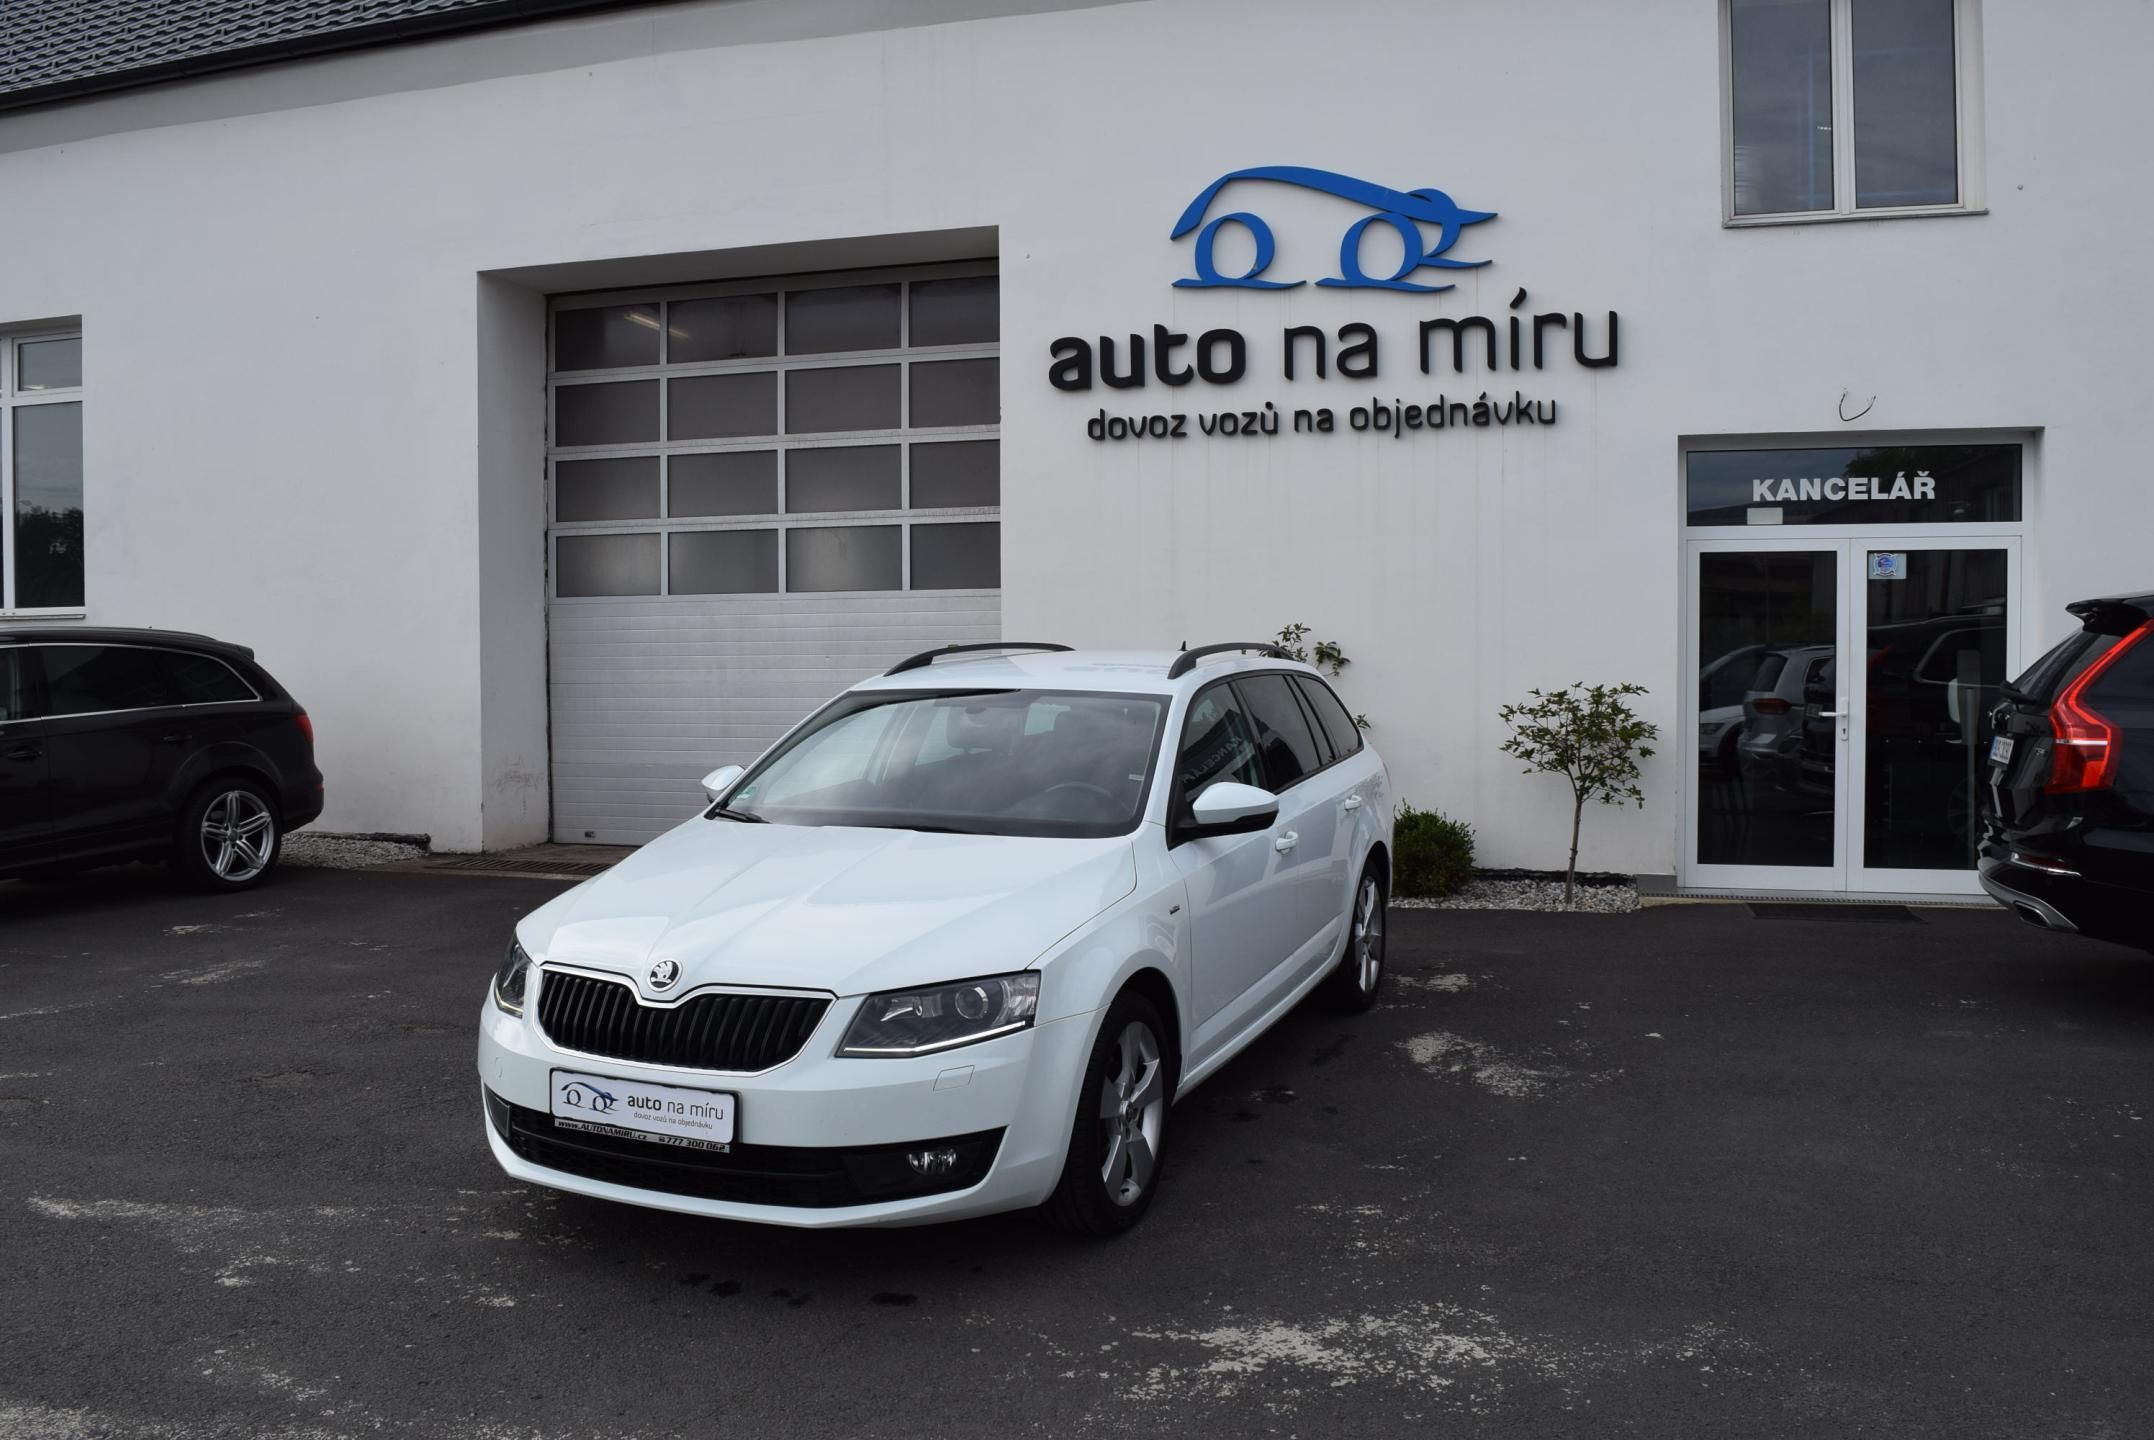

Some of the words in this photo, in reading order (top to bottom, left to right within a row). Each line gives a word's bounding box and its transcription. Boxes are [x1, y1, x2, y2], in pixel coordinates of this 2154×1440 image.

[1048, 323, 1247, 394] auto
[1283, 322, 1379, 382] na
[1419, 287, 1619, 376] míru
[1087, 408, 1188, 443] dovoz
[1198, 401, 1279, 438] vozů
[1293, 408, 1335, 435] na
[1349, 390, 1557, 440] objednávku
[1752, 470, 1936, 502] KANCELÁŘ
[627, 1095, 662, 1111] auto
[667, 1101, 684, 1115] na
[690, 1102, 724, 1120] míru
[633, 1111, 651, 1120] dovoz
[667, 1136, 685, 1145] 777
[685, 1139, 705, 1149] 300
